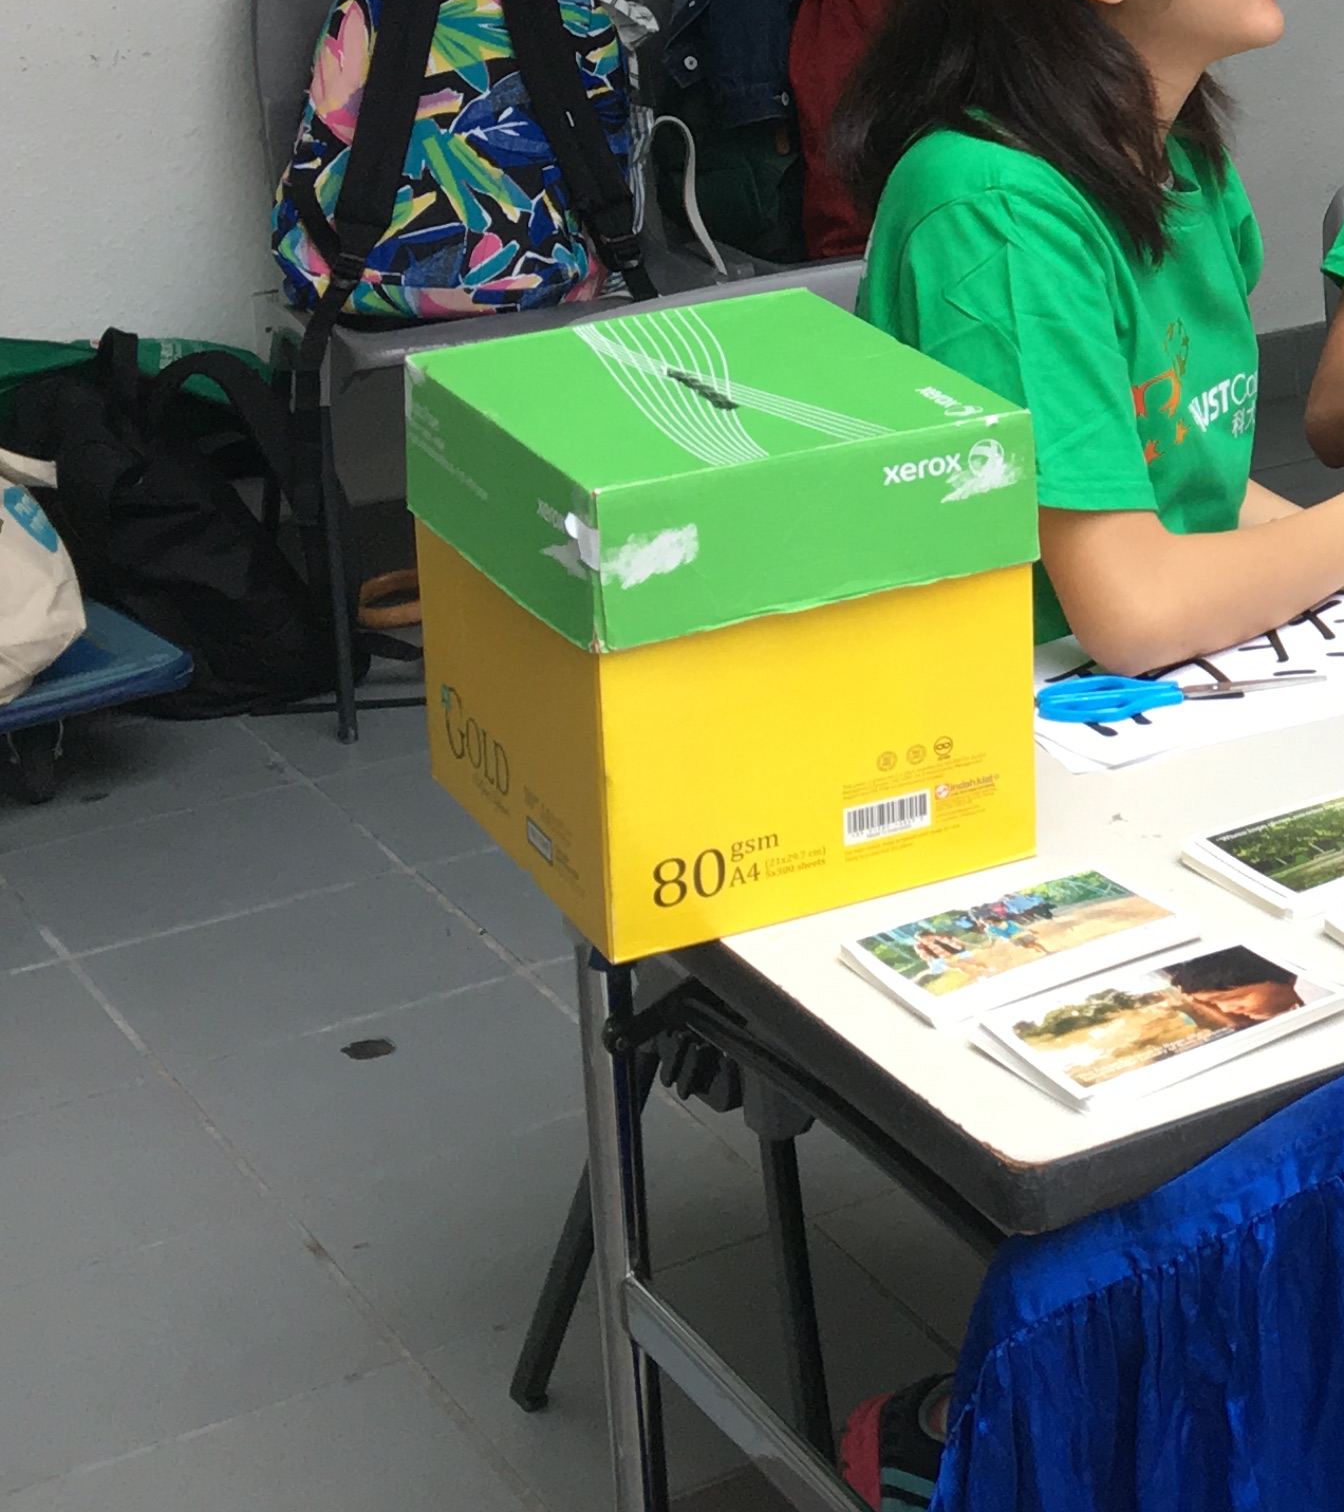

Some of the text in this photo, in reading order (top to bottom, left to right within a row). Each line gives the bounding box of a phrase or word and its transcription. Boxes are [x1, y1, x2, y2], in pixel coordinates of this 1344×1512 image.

[883, 452, 962, 487] xerox
[730, 832, 779, 863] gsm
[808, 845, 827, 859] cm)
[653, 848, 726, 909] 80
[728, 862, 761, 889] A4
[796, 858, 827, 872] sheets
